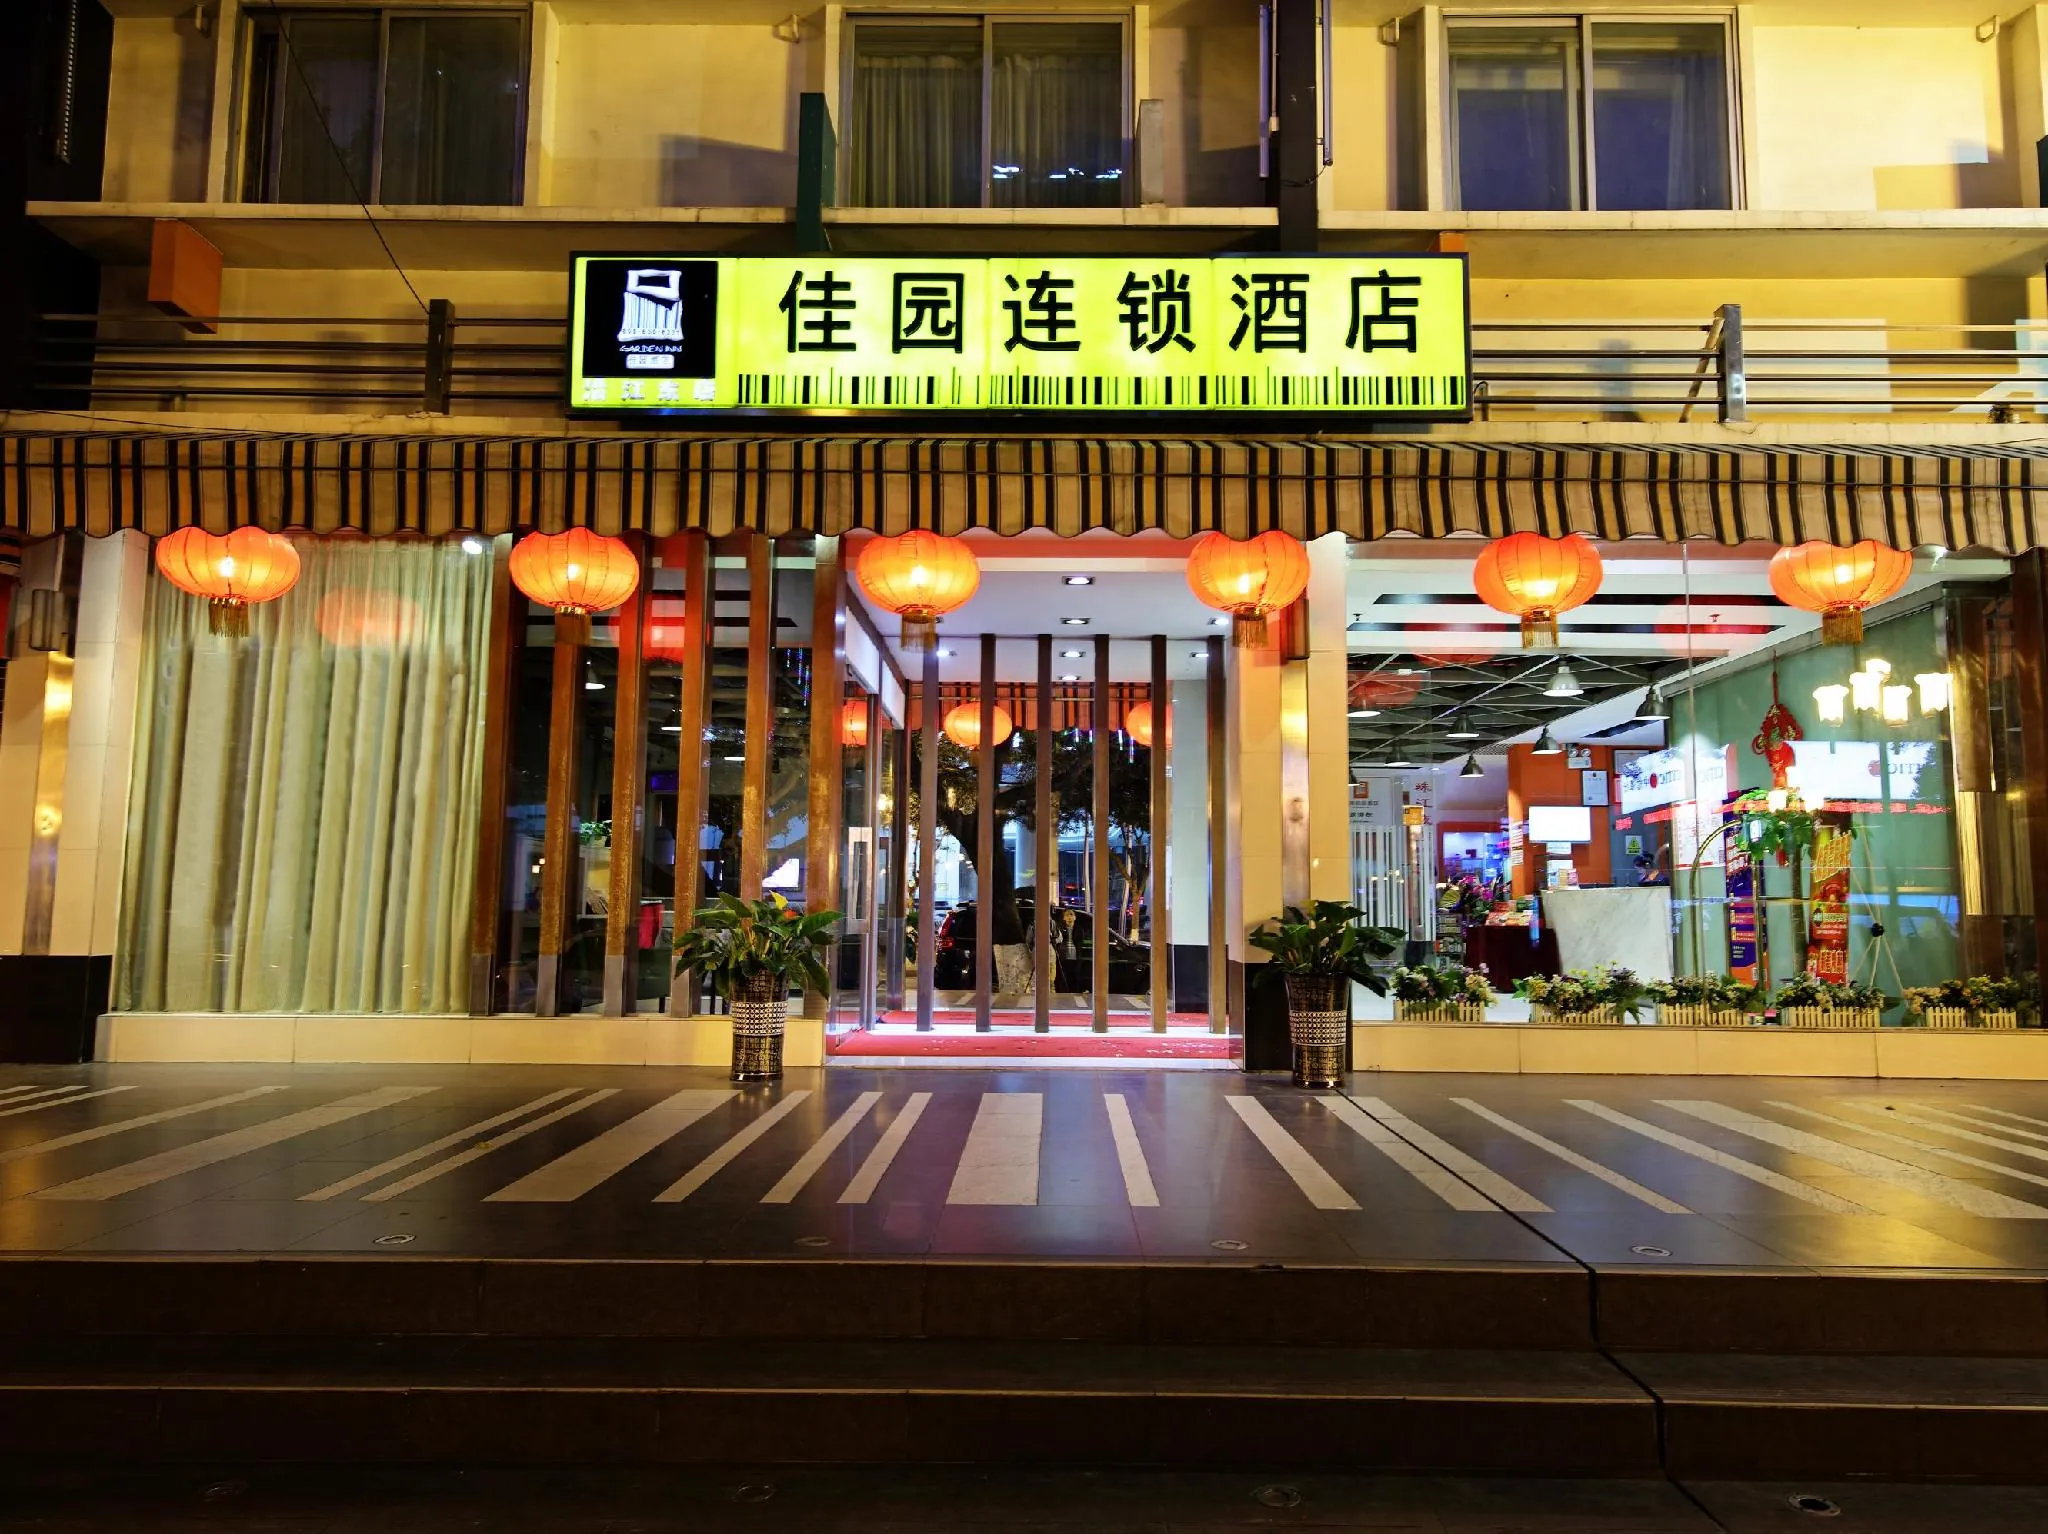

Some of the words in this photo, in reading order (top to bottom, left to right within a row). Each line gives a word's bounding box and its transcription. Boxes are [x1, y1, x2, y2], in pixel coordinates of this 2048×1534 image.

[780, 269, 1421, 355] 佳园连锁酒店
